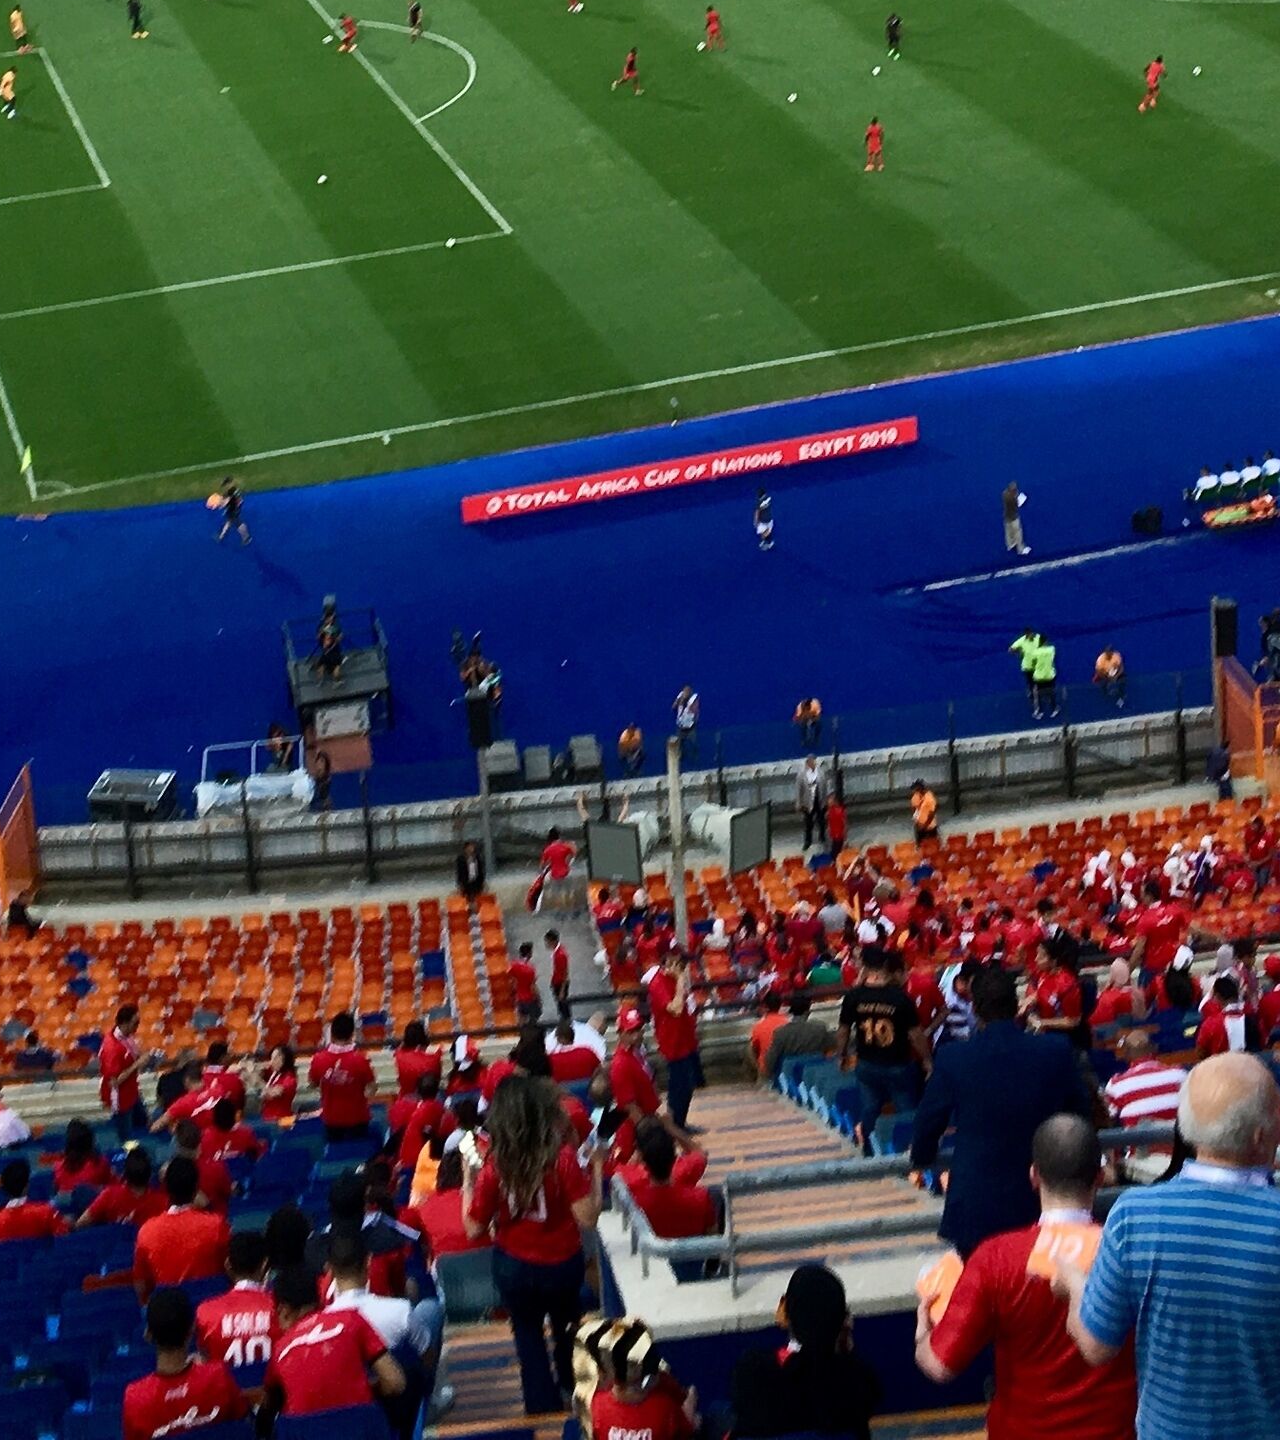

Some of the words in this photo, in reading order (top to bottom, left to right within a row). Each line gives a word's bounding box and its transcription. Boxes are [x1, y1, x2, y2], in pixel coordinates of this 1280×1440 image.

[503, 487, 572, 512] TOTAL
[576, 475, 640, 500] AFRICA
[643, 467, 681, 488] CUP
[684, 463, 708, 481] OF
[711, 449, 784, 476] NATIONS
[798, 433, 857, 461] EGYPT
[859, 426, 899, 450] 2019
